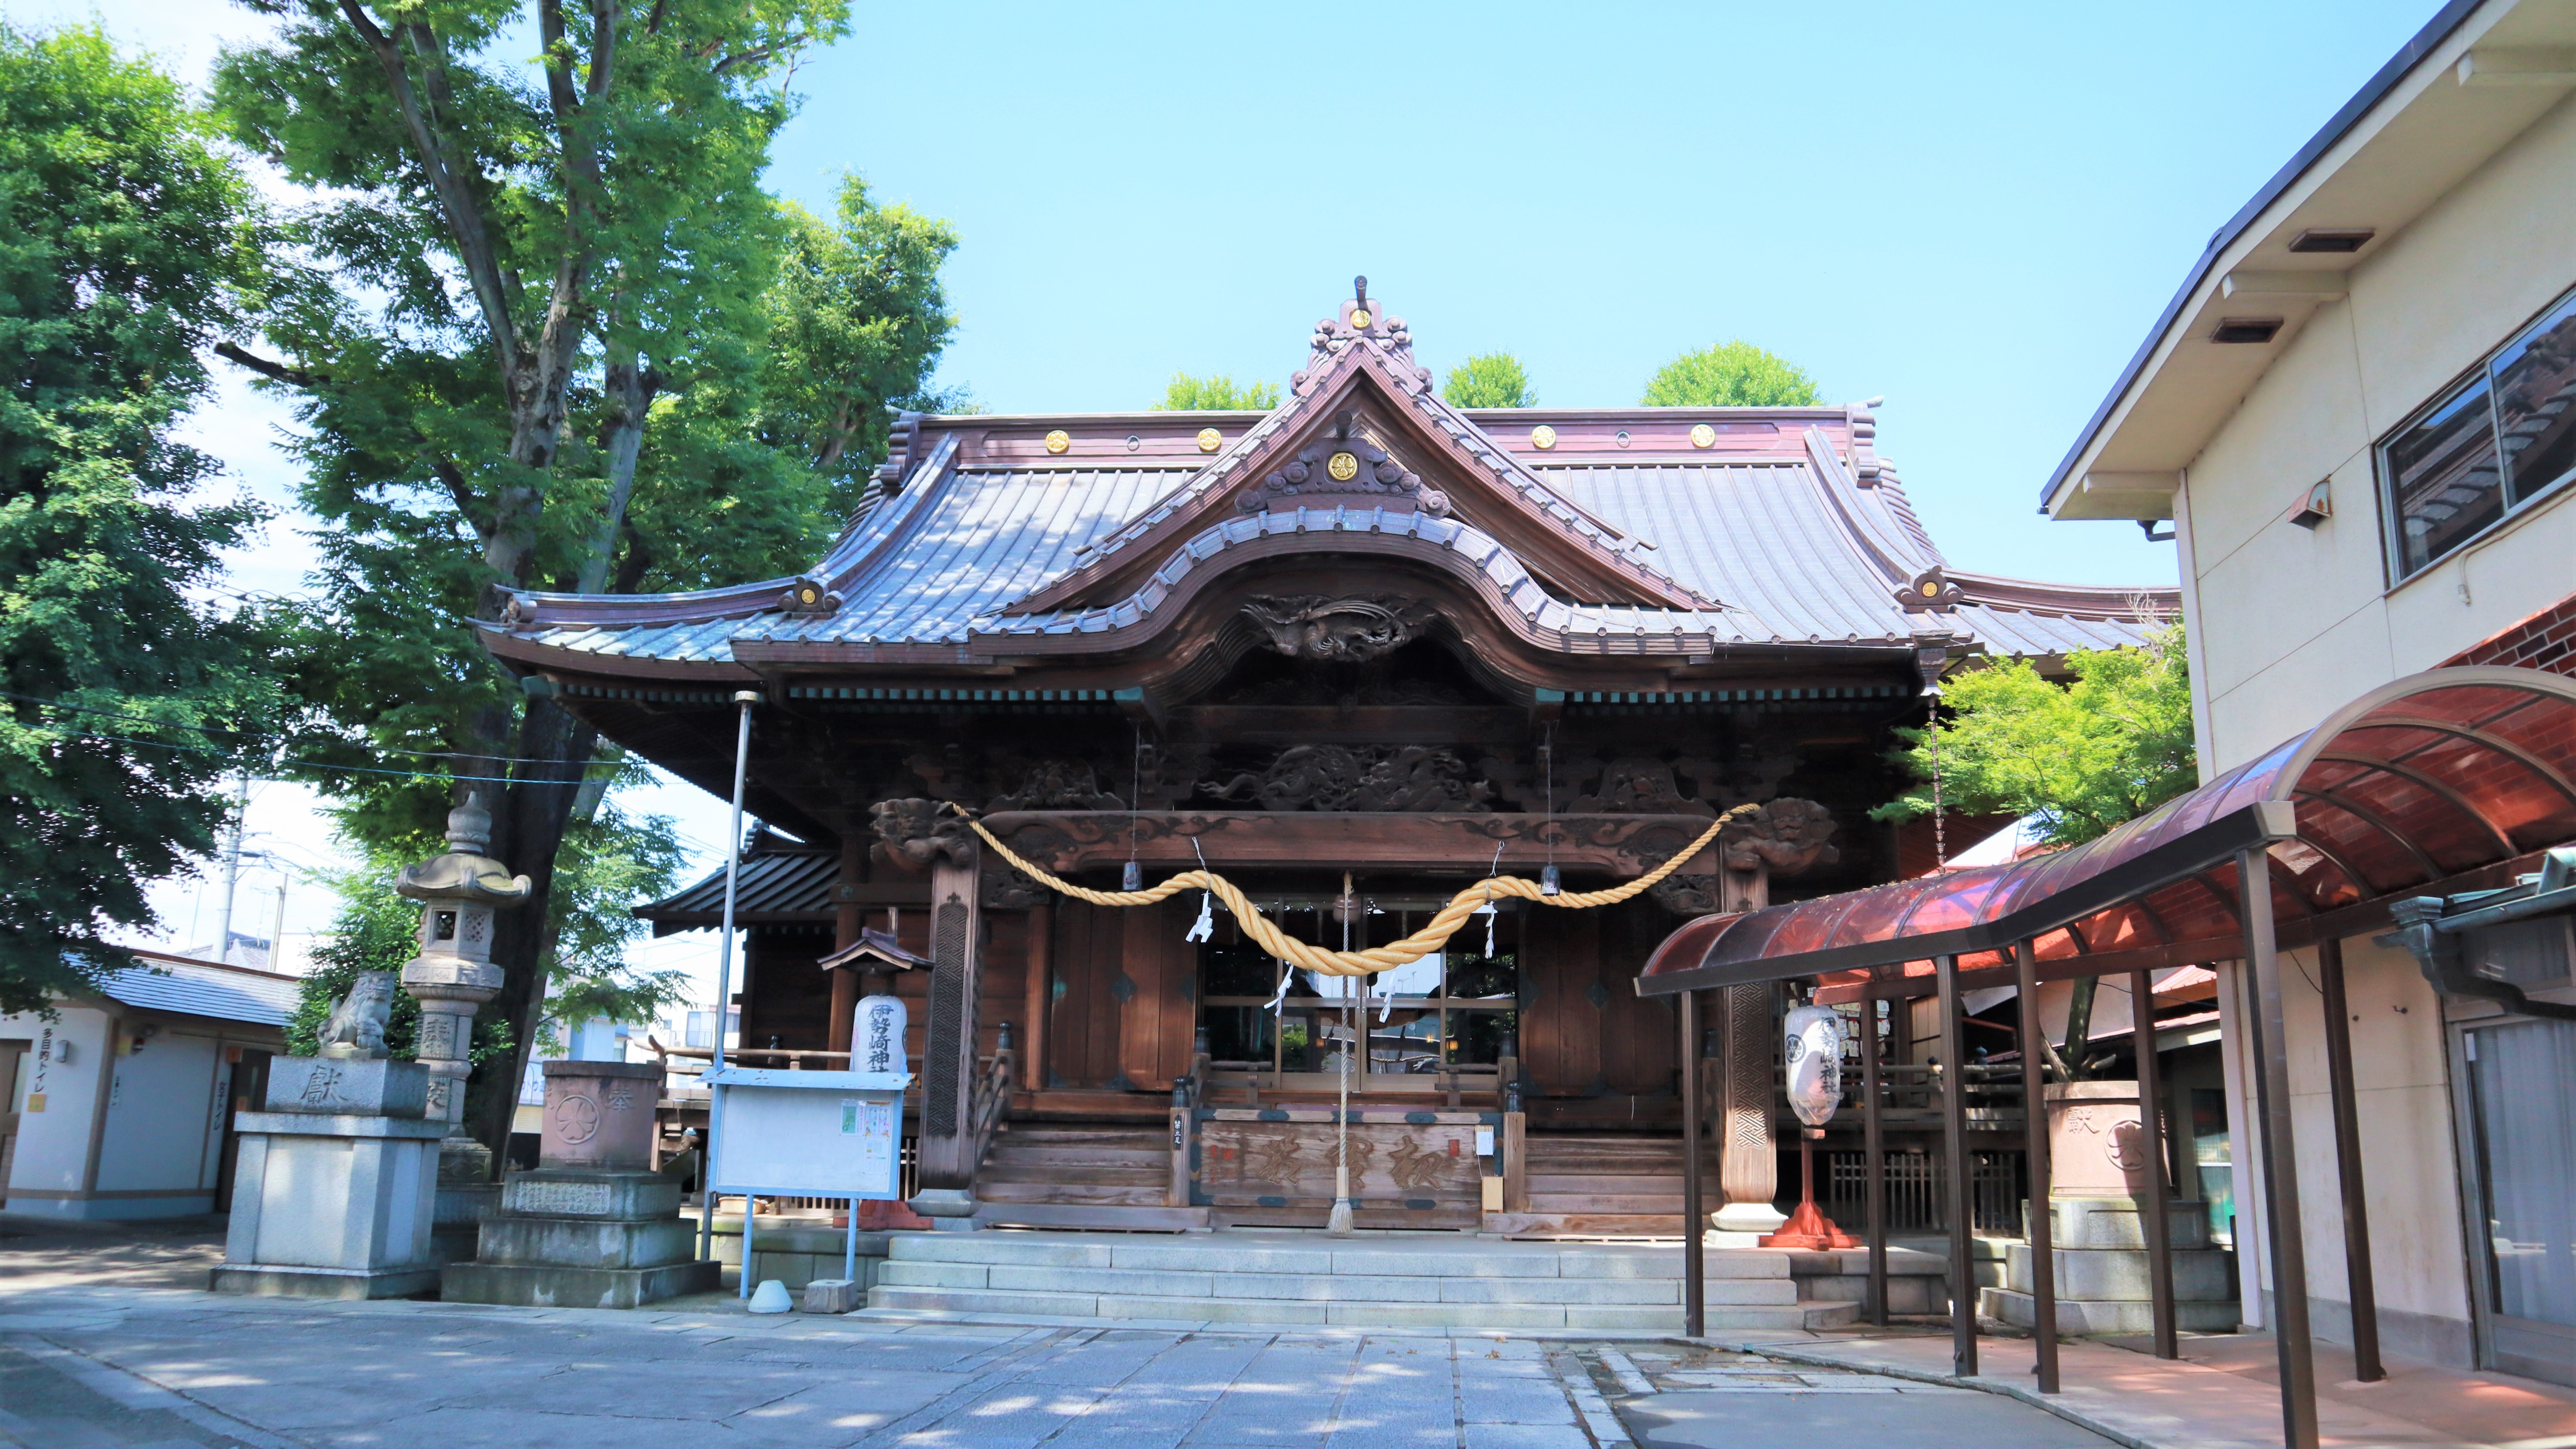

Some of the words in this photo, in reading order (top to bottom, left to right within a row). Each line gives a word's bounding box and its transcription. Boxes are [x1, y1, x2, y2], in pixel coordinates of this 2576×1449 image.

[34, 1028, 53, 1093] 多目的トイレ
